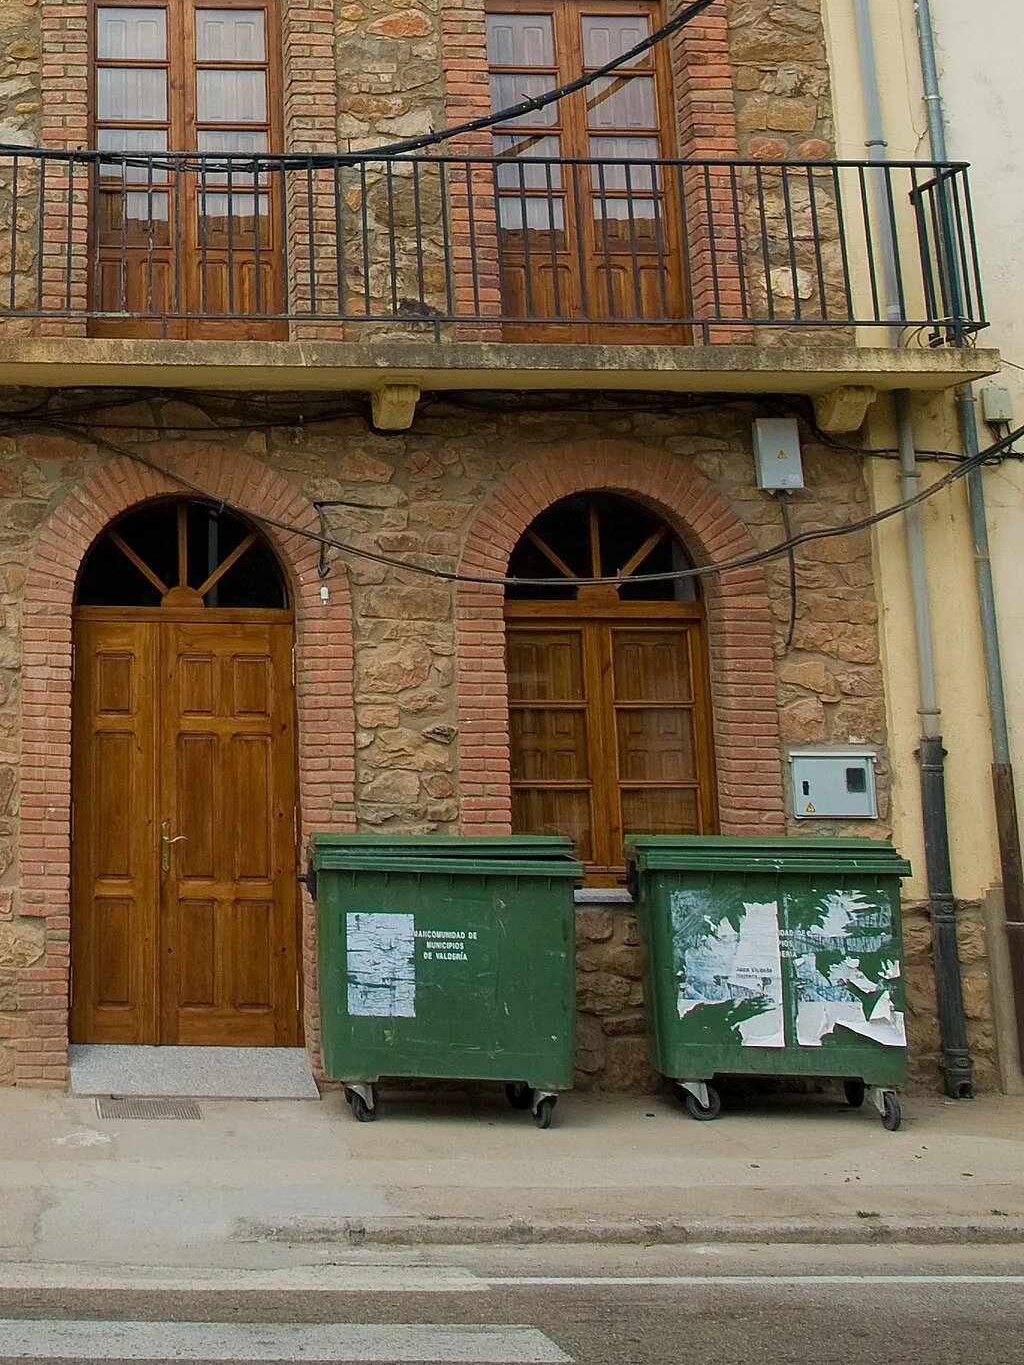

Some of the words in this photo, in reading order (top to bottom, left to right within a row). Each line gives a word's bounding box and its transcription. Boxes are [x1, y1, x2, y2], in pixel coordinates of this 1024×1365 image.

[468, 931, 478, 939] DE
[426, 941, 464, 950] MUNICIPIOS
[423, 952, 433, 960] DE
[435, 951, 468, 961] VALDERÍA
